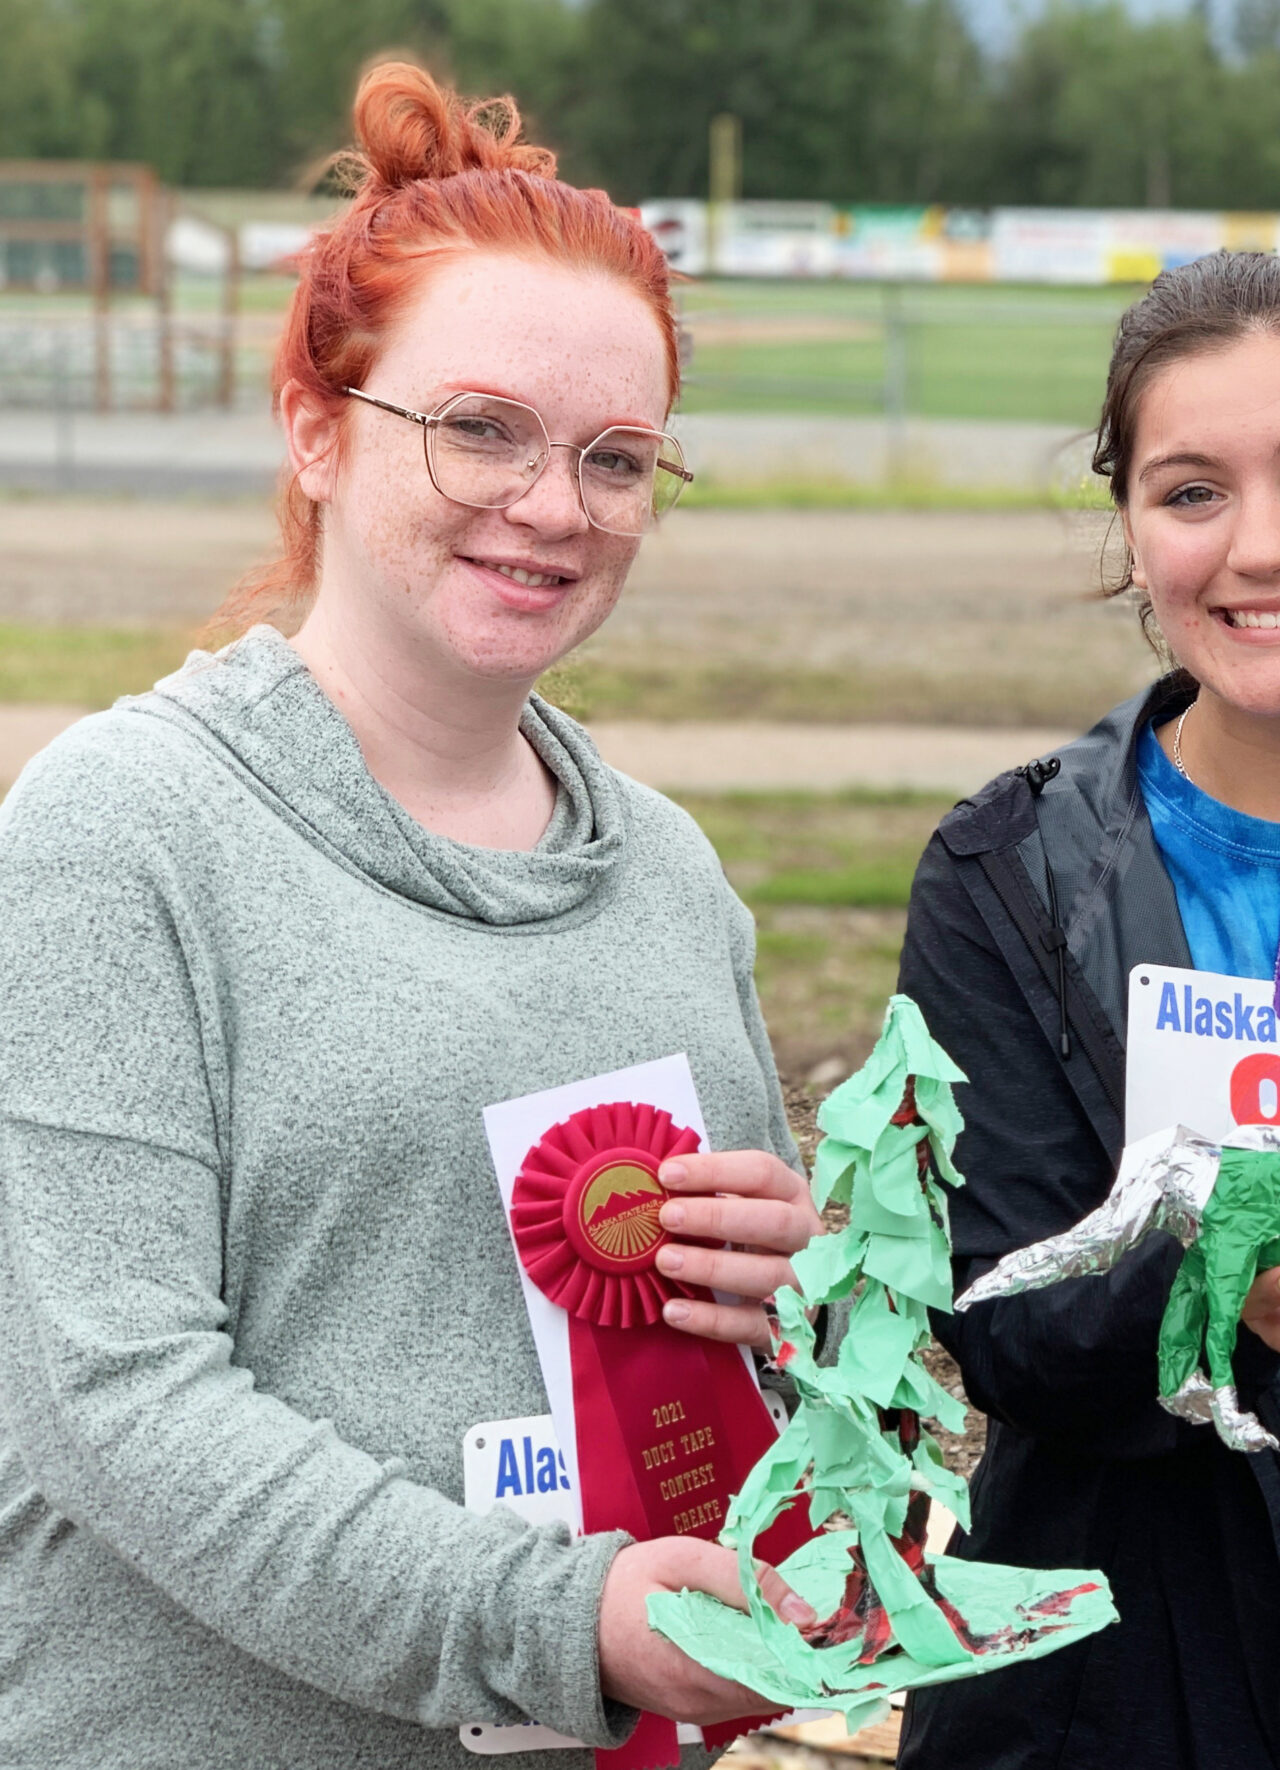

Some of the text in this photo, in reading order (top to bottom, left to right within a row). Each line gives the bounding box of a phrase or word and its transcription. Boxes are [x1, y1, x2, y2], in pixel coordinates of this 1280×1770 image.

[1156, 981, 1277, 1043] Alaska
[588, 1198, 658, 1235] ALASKA STATE FAIR
[652, 1400, 686, 1428] 2021
[642, 1426, 716, 1470] DUCT TAPE
[659, 1462, 716, 1501] CONTEST
[673, 1499, 722, 1535] CREATE
